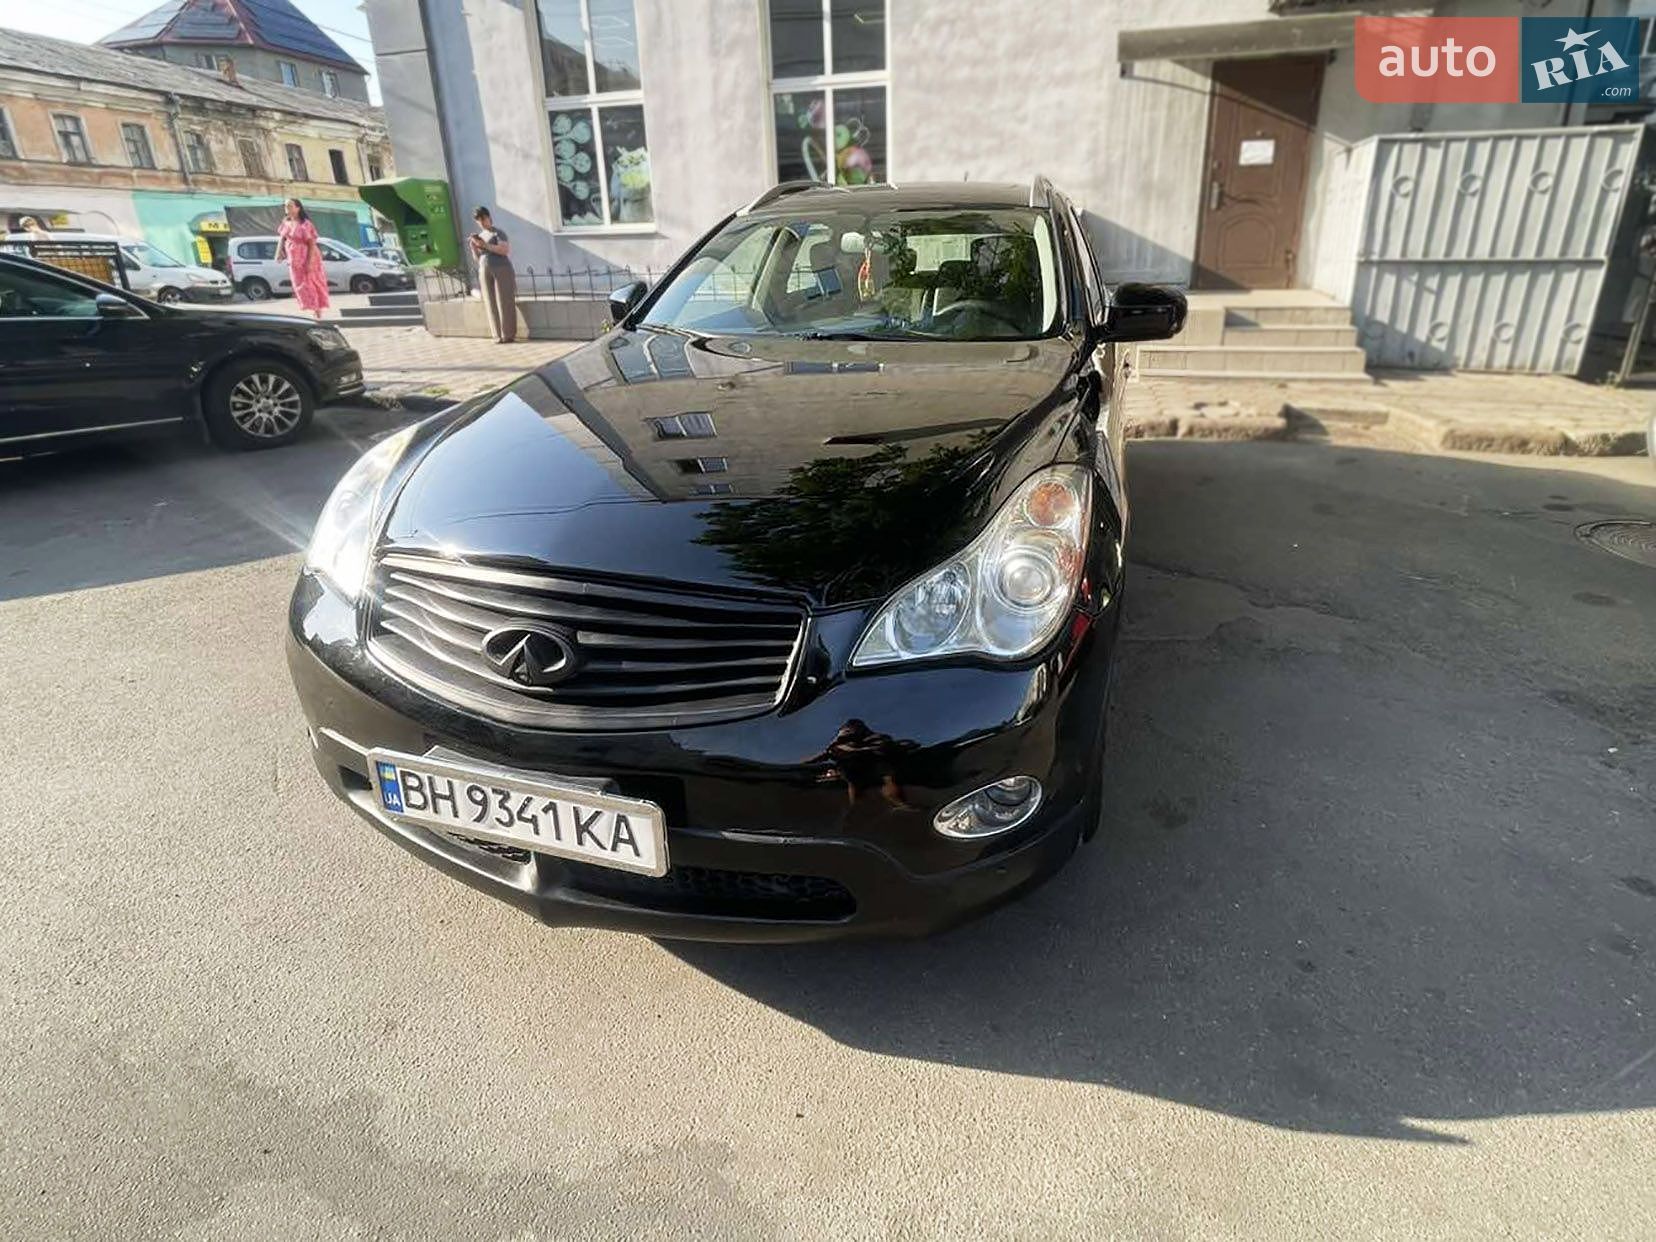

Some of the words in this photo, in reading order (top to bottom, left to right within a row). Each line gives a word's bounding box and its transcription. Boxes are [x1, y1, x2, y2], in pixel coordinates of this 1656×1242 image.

[399, 769, 460, 818] BH
[466, 783, 563, 842] 9341
[572, 805, 642, 857] KA
